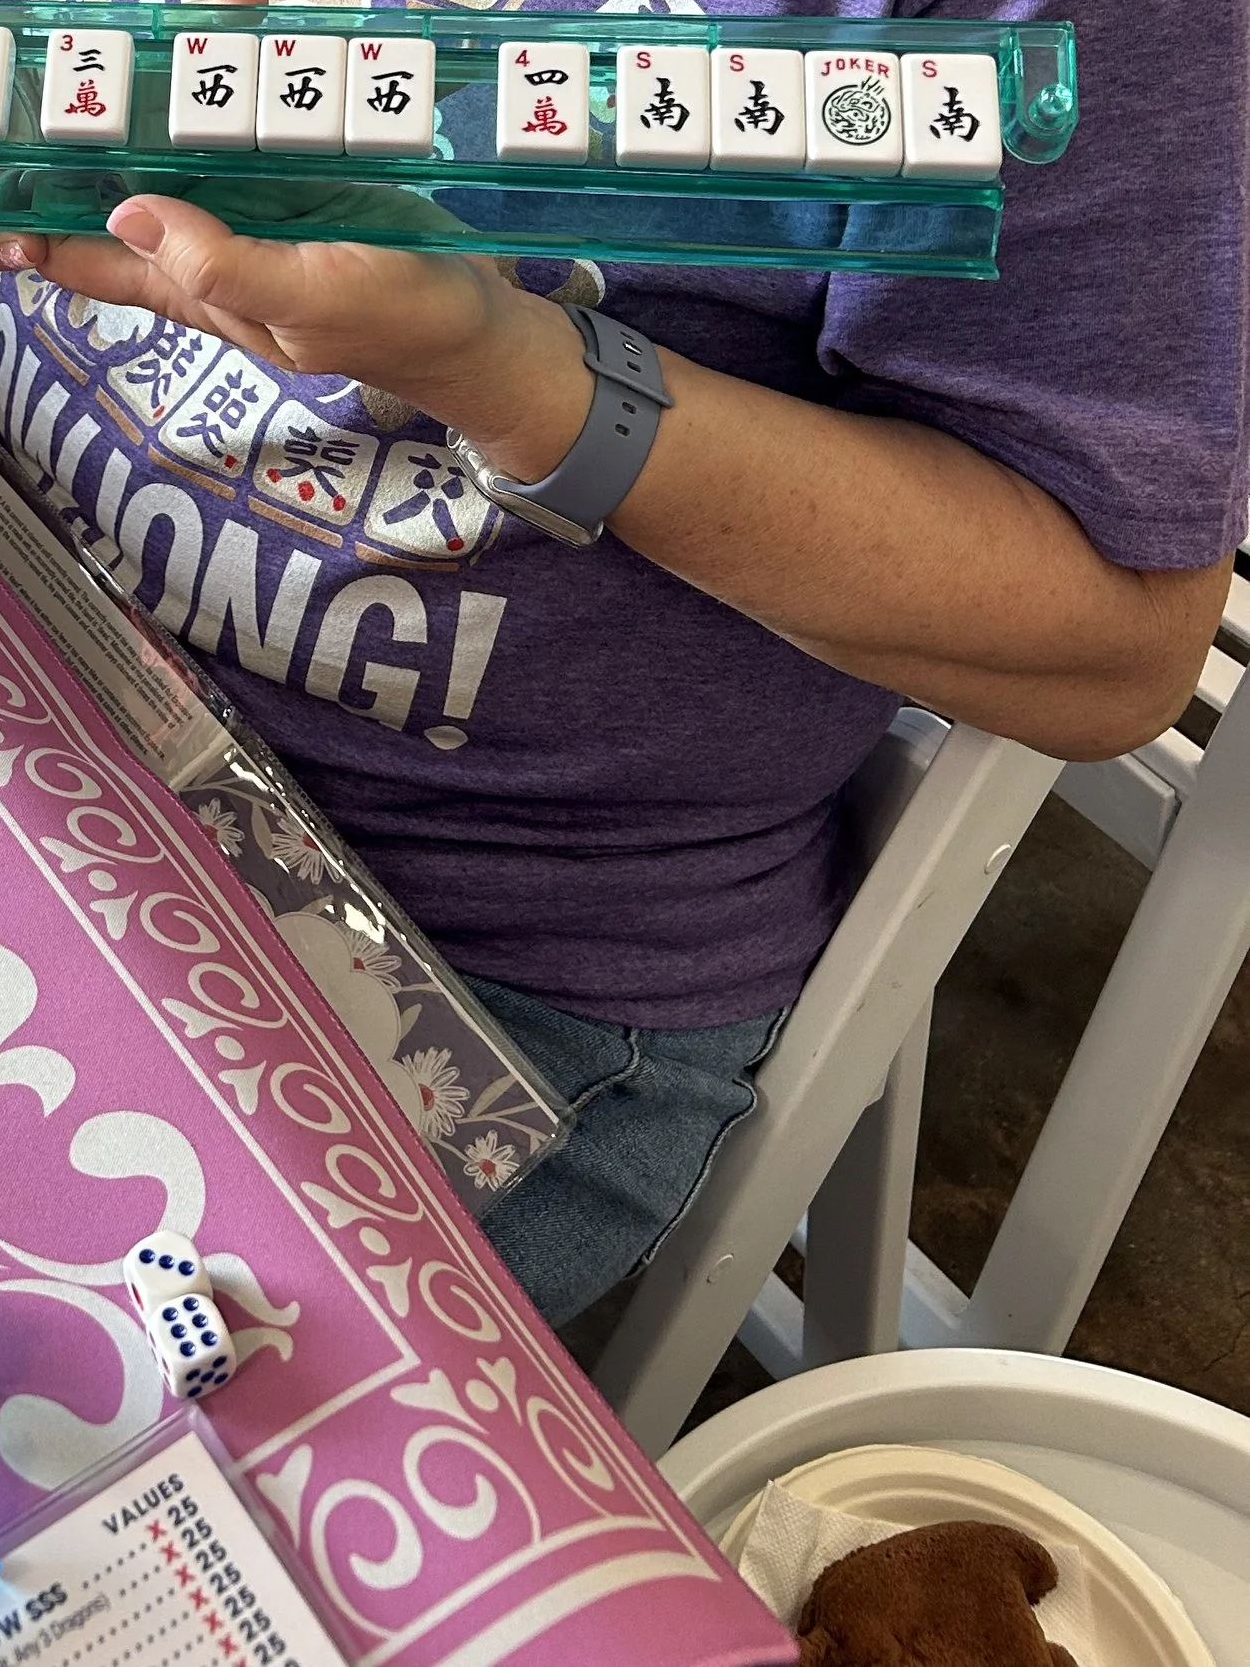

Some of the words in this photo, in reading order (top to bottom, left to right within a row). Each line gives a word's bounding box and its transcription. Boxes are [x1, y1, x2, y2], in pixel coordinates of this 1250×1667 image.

[60, 35, 74, 51] 3
[187, 38, 208, 55] W
[274, 40, 297, 57] W
[360, 43, 383, 61] W
[514, 49, 530, 67] 4
[636, 52, 651, 70] S
[729, 54, 745, 72] S
[819, 57, 892, 80] JOKER
[922, 59, 938, 78] S
[191, 64, 239, 110] 西
[279, 66, 328, 112] 西
[366, 70, 415, 116] 西
[639, 77, 690, 132] 南
[733, 80, 786, 135] 南
[928, 85, 981, 142] 南
[102, 1473, 184, 1535] VALUES
[181, 1516, 214, 1550] 25
[25, 1582, 68, 1622] SSS
[167, 1495, 199, 1527] 25
[195, 1539, 228, 1573] 25
[209, 1562, 242, 1595] 25
[223, 1584, 256, 1619] 25
[239, 1607, 272, 1643] 25
[253, 1631, 286, 1667] 25
